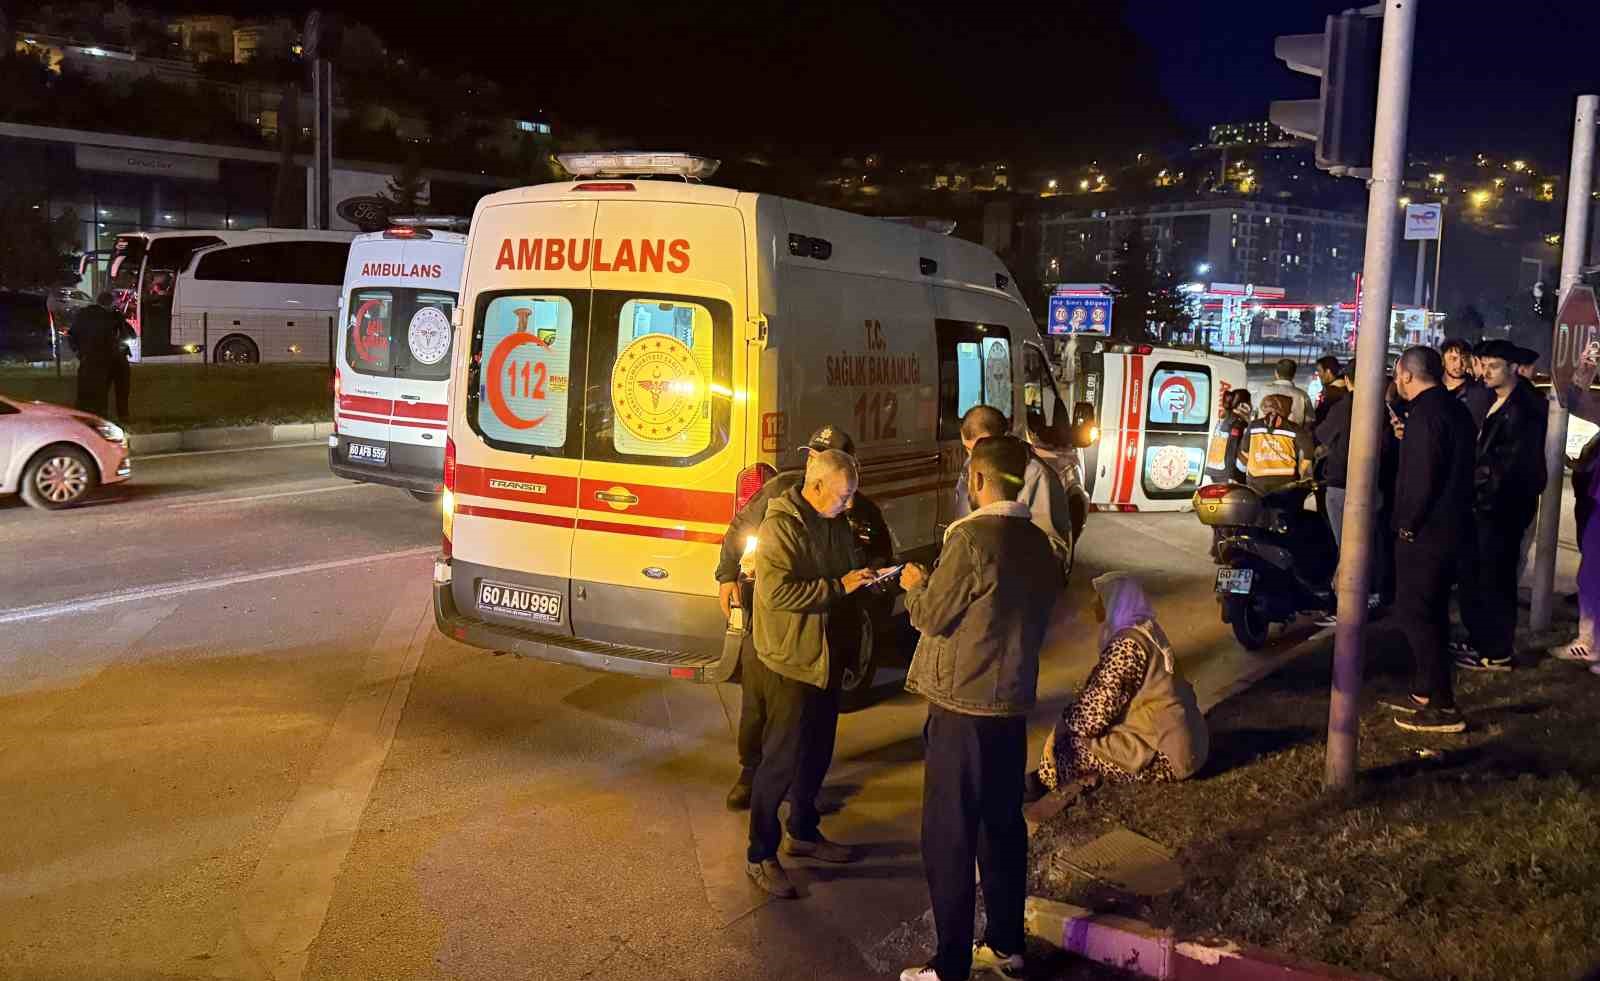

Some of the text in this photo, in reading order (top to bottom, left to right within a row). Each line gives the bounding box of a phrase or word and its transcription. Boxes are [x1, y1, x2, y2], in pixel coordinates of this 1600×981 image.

[361, 262, 442, 278] AMBULANS
[494, 237, 691, 274] AMBULANS
[863, 319, 887, 351] T.C.
[507, 359, 547, 400] 112
[825, 350, 866, 387] SAĞLIK
[1168, 388, 1186, 411] 112
[853, 391, 898, 441] 112
[350, 444, 359, 456] 60
[490, 479, 545, 493] TRANSIT
[482, 586, 500, 605] 60
[501, 589, 530, 610] AAU
[530, 594, 558, 615] 996
